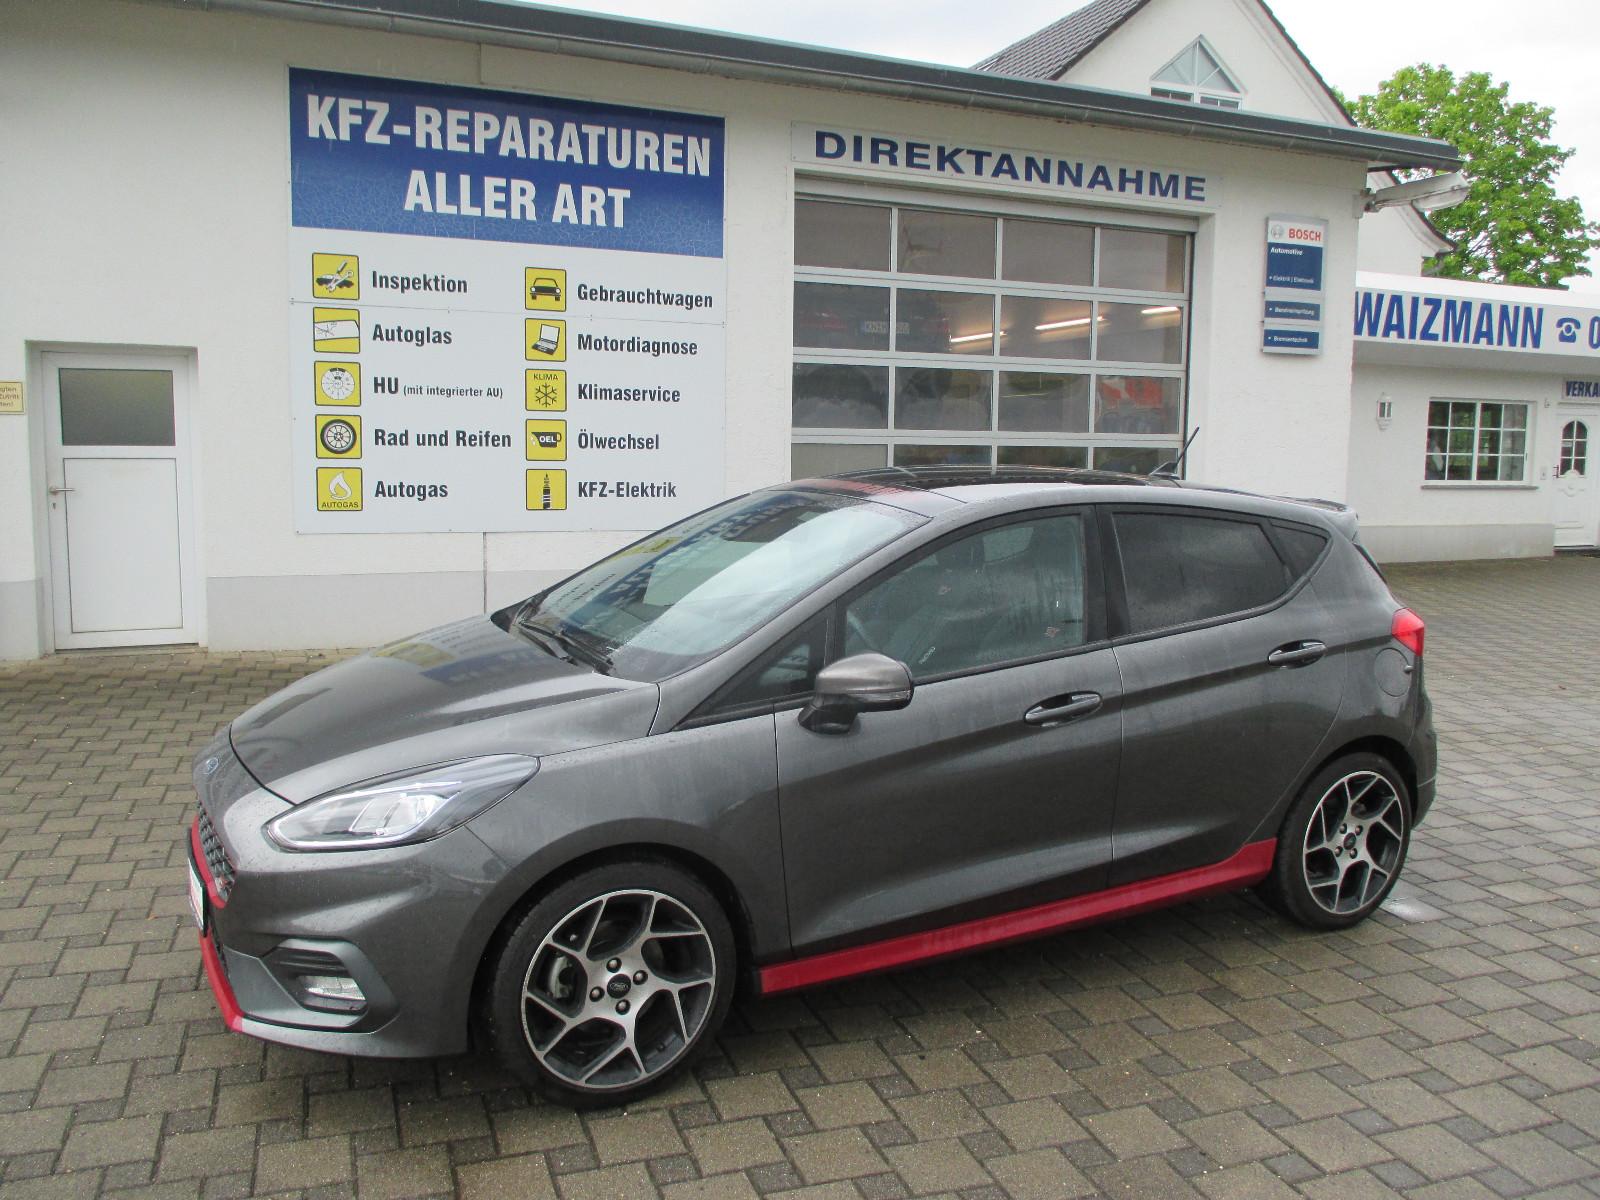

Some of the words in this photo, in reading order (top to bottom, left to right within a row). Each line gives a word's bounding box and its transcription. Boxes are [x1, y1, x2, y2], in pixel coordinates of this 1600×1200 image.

[307, 94, 711, 177] KFZ-REPARATUREN
[815, 130, 1206, 201] DIREKTANNAHME
[404, 170, 536, 221] ALLER
[552, 184, 630, 228] ART
[1288, 228, 1321, 241] BOSCH
[1270, 247, 1303, 256] Automotive
[373, 271, 467, 293] Inspektion
[578, 284, 712, 310] Gebrauchtwagen
[1353, 291, 1544, 349] WAIZMANN
[373, 324, 452, 347] Autoglas
[578, 334, 697, 357] Motordiagnose
[533, 372, 560, 382] KLIMA
[374, 377, 398, 394] HU
[404, 385, 422, 396] (mit
[427, 386, 482, 398] integrierter
[487, 388, 502, 398] AU)
[578, 384, 680, 402] Klimaservice
[1566, 381, 1600, 398] VERKA
[375, 429, 408, 446] Rad
[417, 430, 448, 446] und
[456, 430, 511, 447] Reifen
[539, 435, 557, 444] OEL
[578, 429, 659, 449] Ölwechsel
[375, 481, 448, 501] Autogas
[579, 482, 676, 497] KFZ-Elektrik
